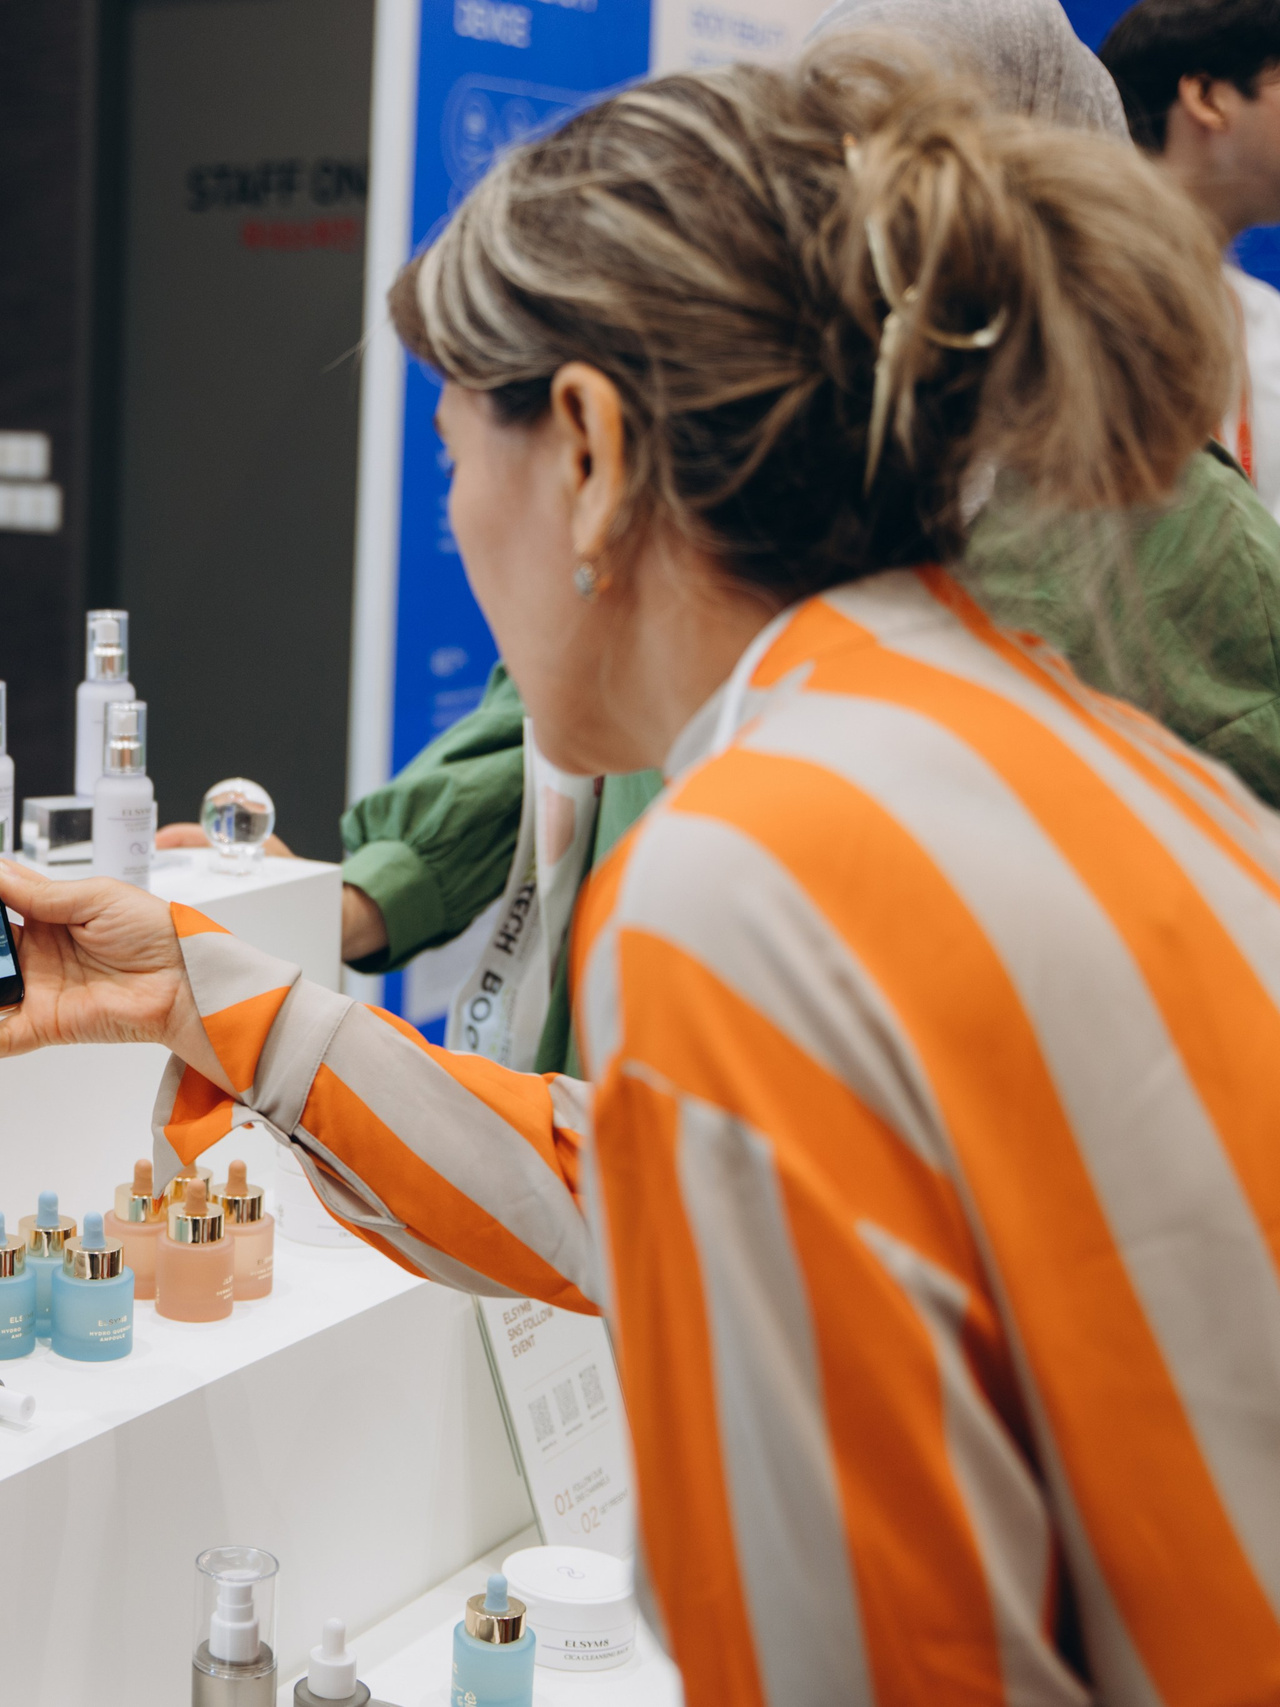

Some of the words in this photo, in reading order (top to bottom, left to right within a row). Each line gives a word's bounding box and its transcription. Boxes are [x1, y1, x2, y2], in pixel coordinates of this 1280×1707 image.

[512, 1333, 535, 1358] EVENT
[554, 1488, 574, 1516] 01
[581, 1504, 601, 1534] 02
[564, 1639, 610, 1649] ELSYM8
